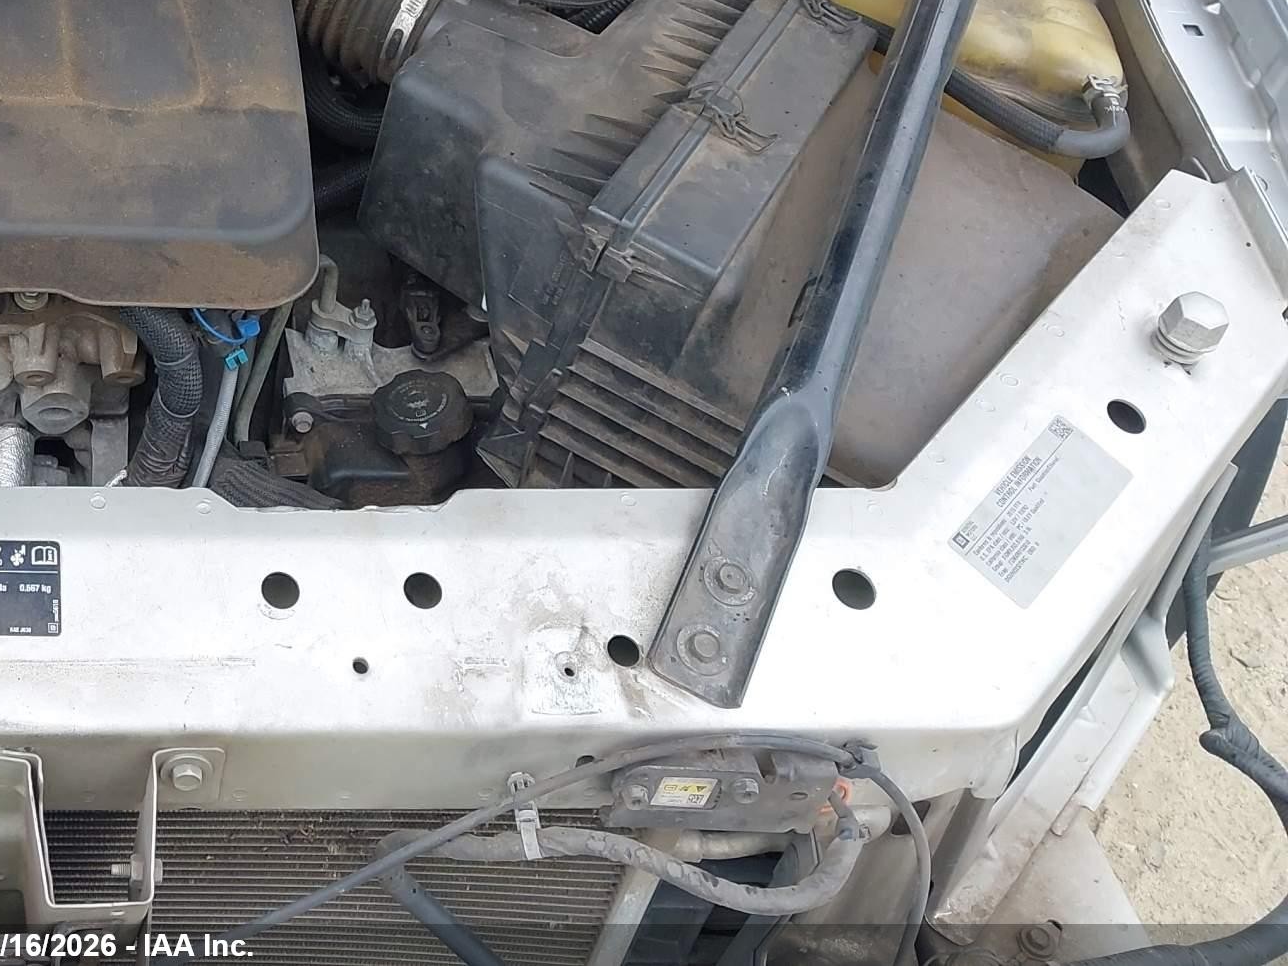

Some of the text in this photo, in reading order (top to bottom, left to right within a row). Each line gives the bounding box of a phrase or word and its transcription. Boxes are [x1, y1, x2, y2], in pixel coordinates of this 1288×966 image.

[996, 476, 1013, 496] VEHICLE
[1011, 456, 1032, 478] EMISSION
[996, 484, 1017, 508] CONTROL
[1014, 456, 1042, 488] INFORMATION
[41, 584, 52, 595] kg
